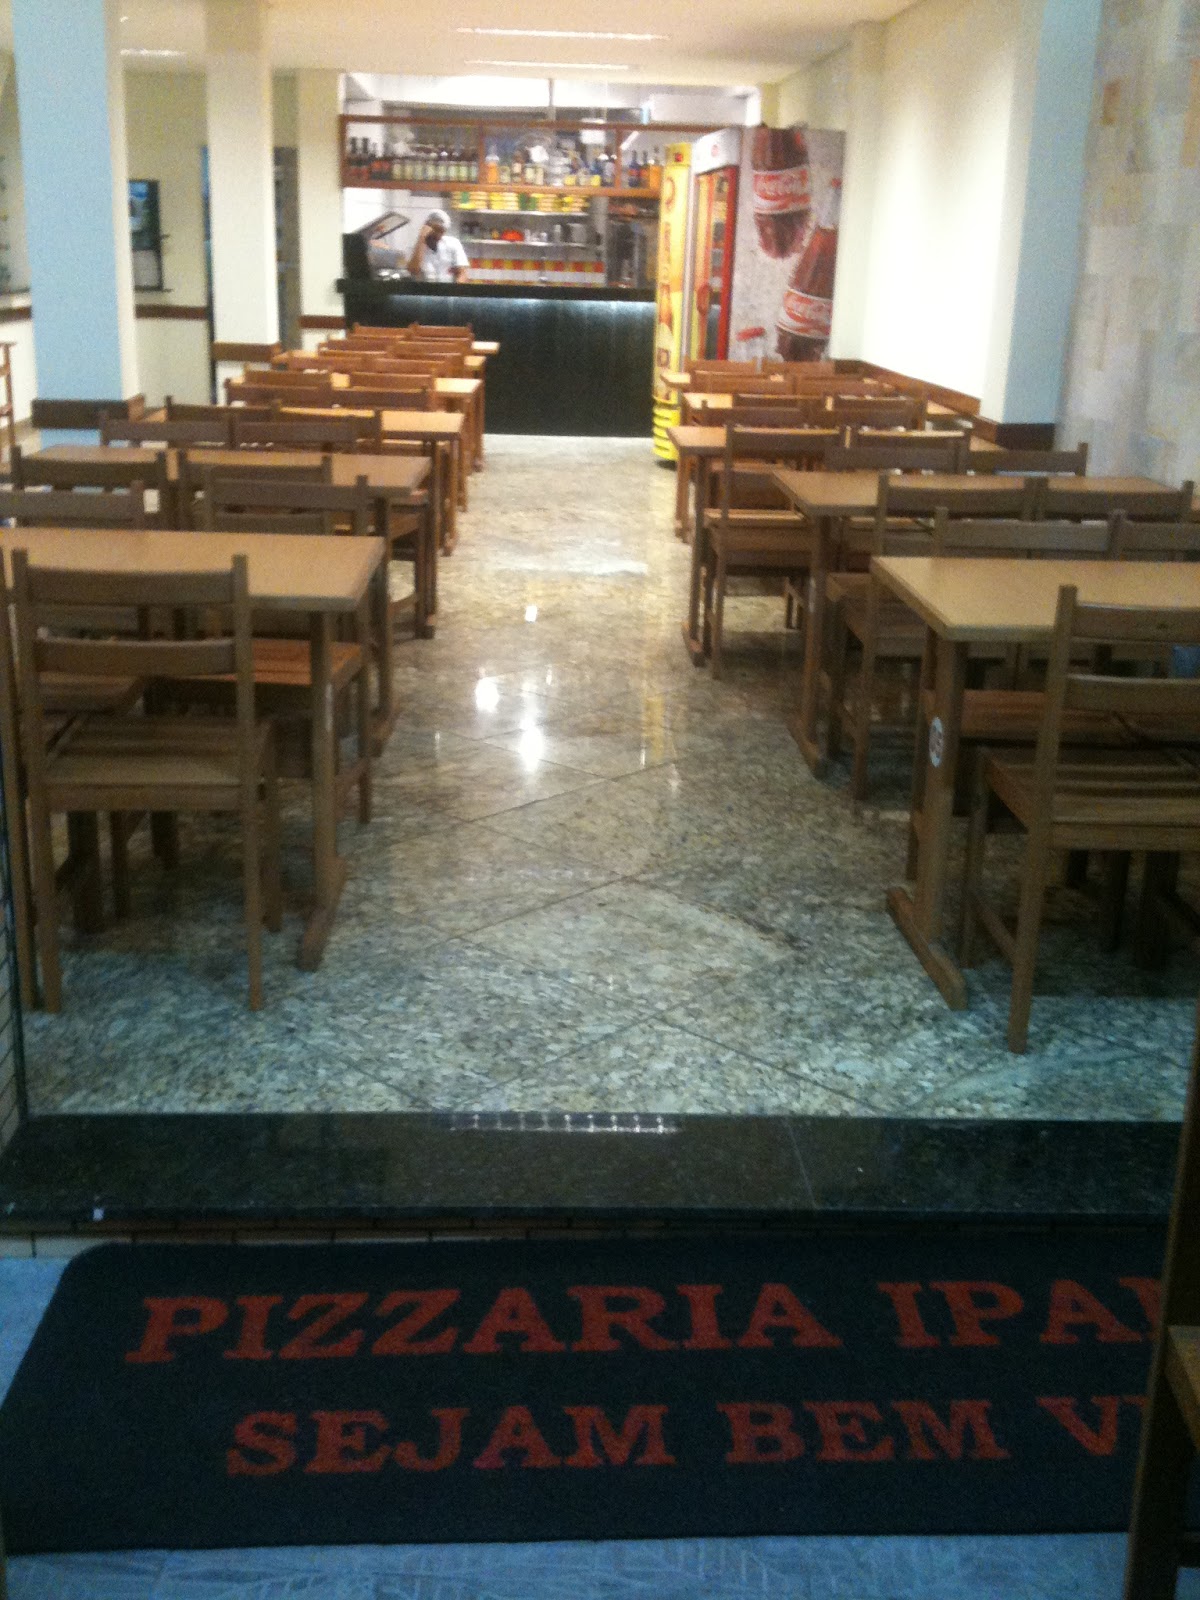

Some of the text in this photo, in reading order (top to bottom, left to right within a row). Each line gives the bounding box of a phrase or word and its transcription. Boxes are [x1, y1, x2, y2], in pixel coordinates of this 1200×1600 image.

[124, 1282, 844, 1364] PIZZARIA
[226, 1394, 1151, 1476] SEJAM BEM V
